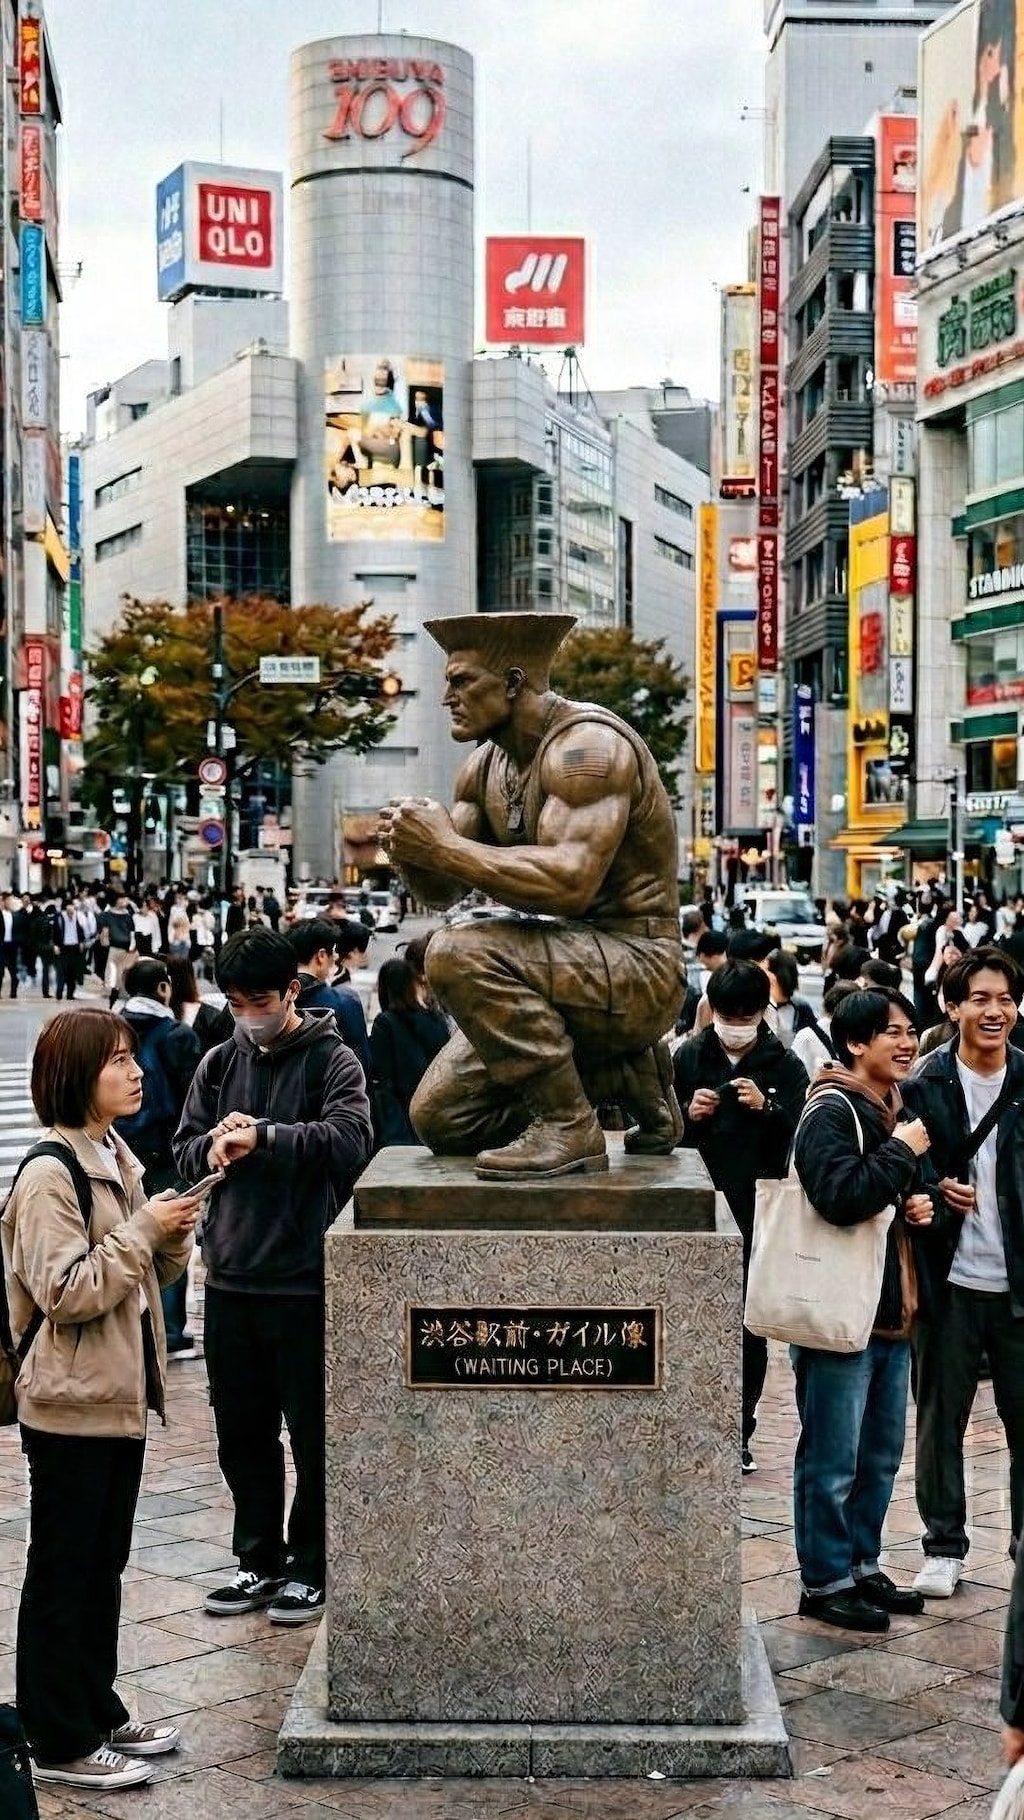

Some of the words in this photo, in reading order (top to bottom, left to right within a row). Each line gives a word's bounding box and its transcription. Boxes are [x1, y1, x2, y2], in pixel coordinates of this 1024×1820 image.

[322, 84, 446, 158] 109
[207, 193, 259, 225] UNI
[207, 226, 264, 257] QLO
[454, 1357, 539, 1377] (WAITING
[547, 1357, 613, 1377] PLACE)
